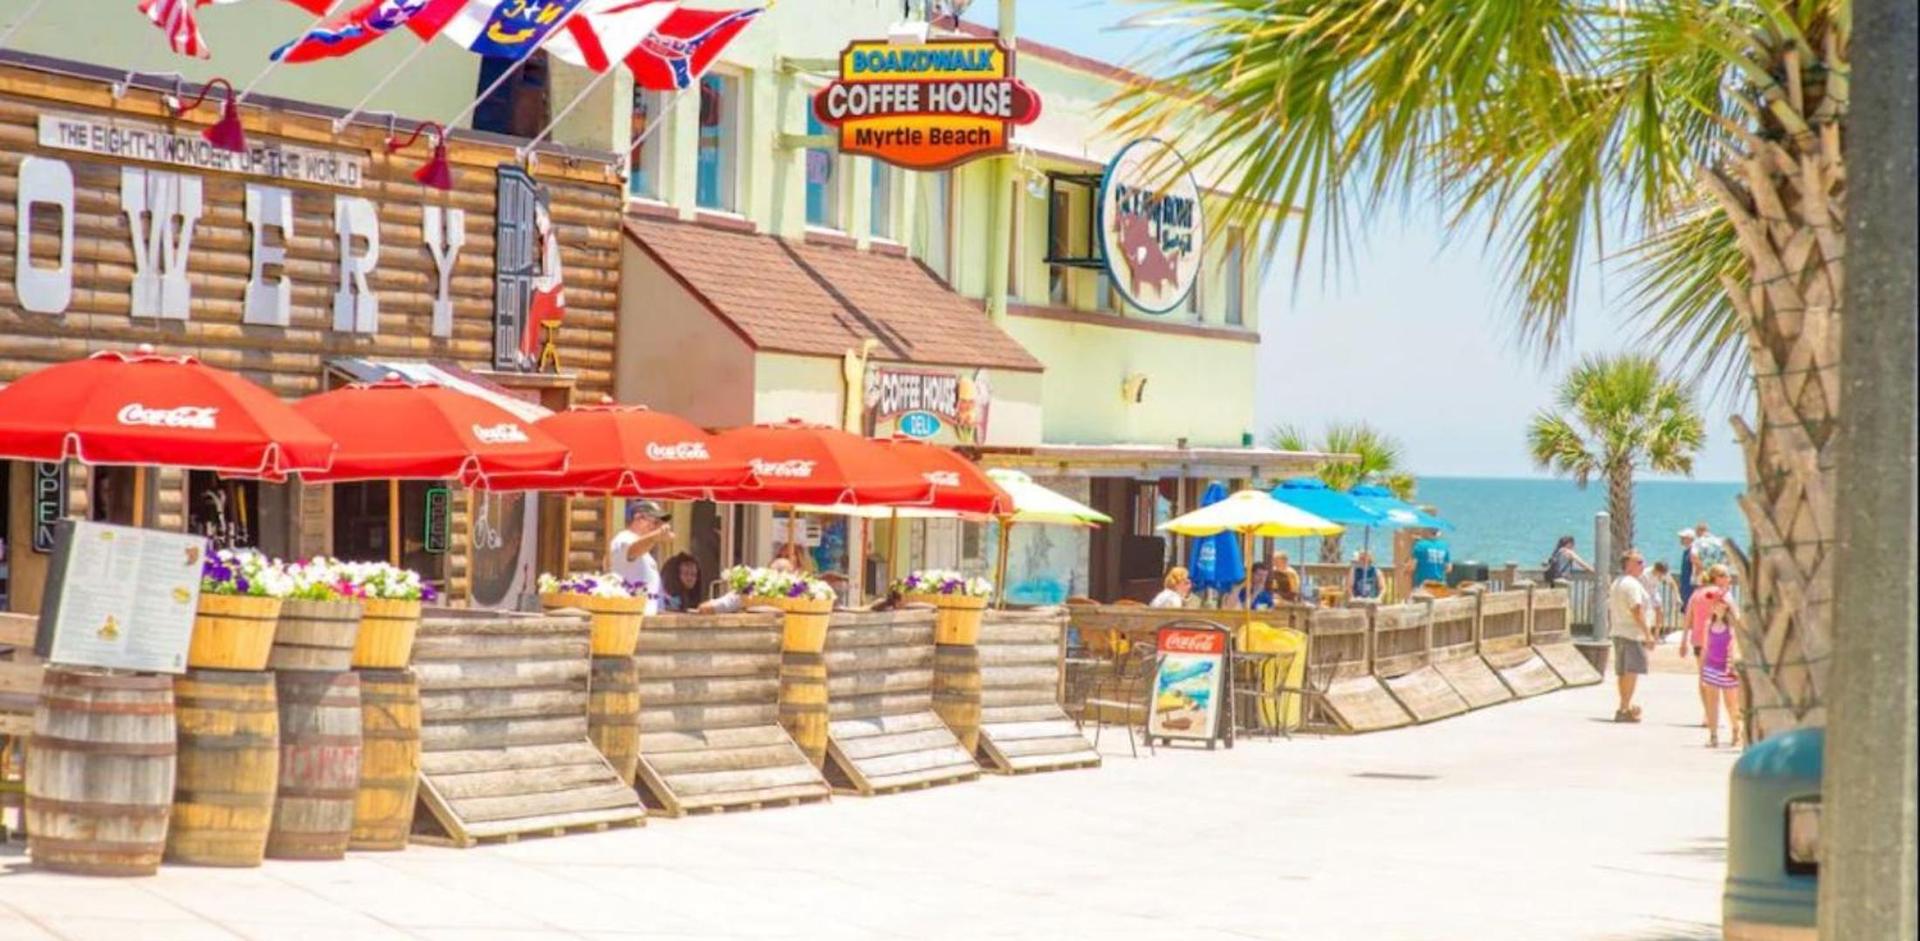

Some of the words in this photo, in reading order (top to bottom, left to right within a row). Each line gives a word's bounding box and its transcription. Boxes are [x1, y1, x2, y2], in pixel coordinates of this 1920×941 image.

[852, 49, 995, 73] BOARDWALK
[827, 83, 920, 118] COFFEE
[928, 81, 1012, 117] HOUSE
[855, 126, 923, 148] Myrtle
[929, 126, 991, 145] Beach
[58, 122, 88, 146] THE
[91, 126, 158, 156] EIGHTH
[163, 131, 233, 169] WONDER
[240, 146, 264, 173] OF
[266, 149, 301, 178] THE
[305, 155, 359, 186] WORLD
[881, 373, 921, 415] COFFEE
[923, 375, 957, 418] HOUSE
[116, 402, 220, 430] Coca-Cola
[910, 414, 932, 435] DELI
[1165, 632, 1217, 652] Coca-Cola
